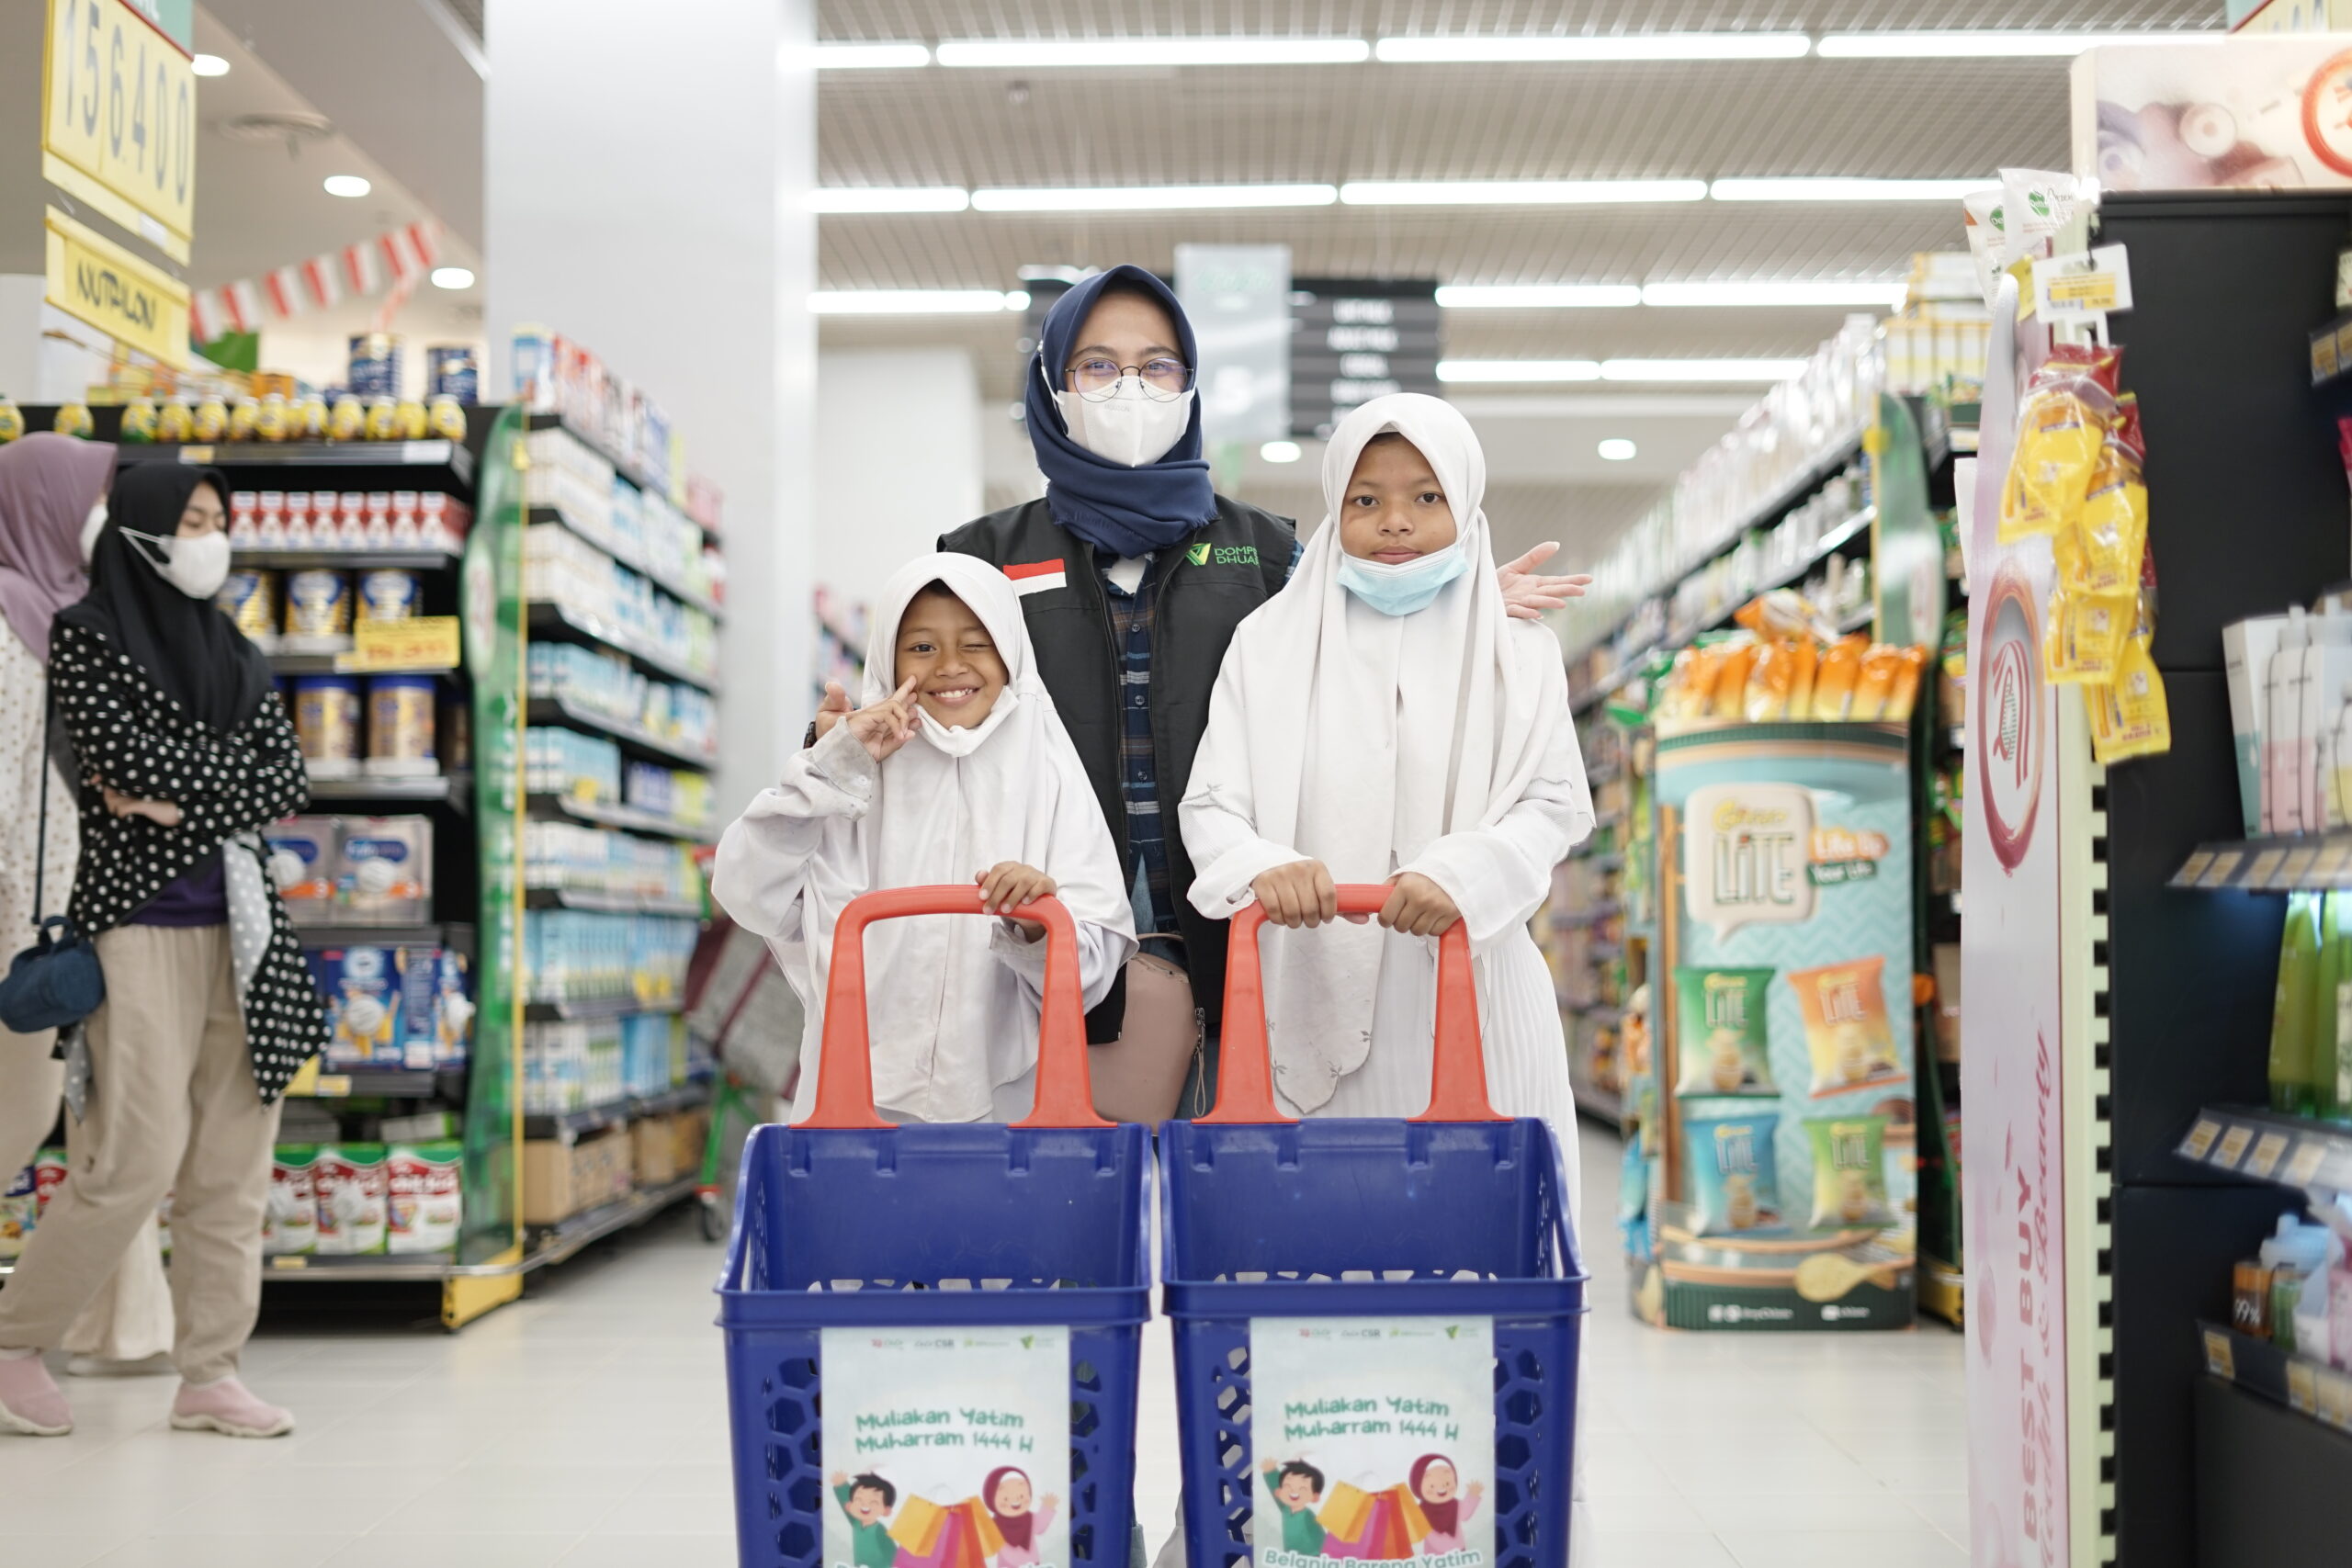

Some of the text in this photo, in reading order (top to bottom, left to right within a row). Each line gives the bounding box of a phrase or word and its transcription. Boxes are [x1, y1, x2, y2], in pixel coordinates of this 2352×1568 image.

[2017, 1164, 2038, 1542] BEST BUY
[855, 1406, 1024, 1432] Muliakan Yatim
[1283, 1395, 1450, 1421] Muliakan Yatim
[854, 1431, 965, 1454] Muharram
[972, 1431, 1012, 1450] 1444
[1283, 1419, 1392, 1442] Muharram
[1399, 1419, 1438, 1438] 1444
